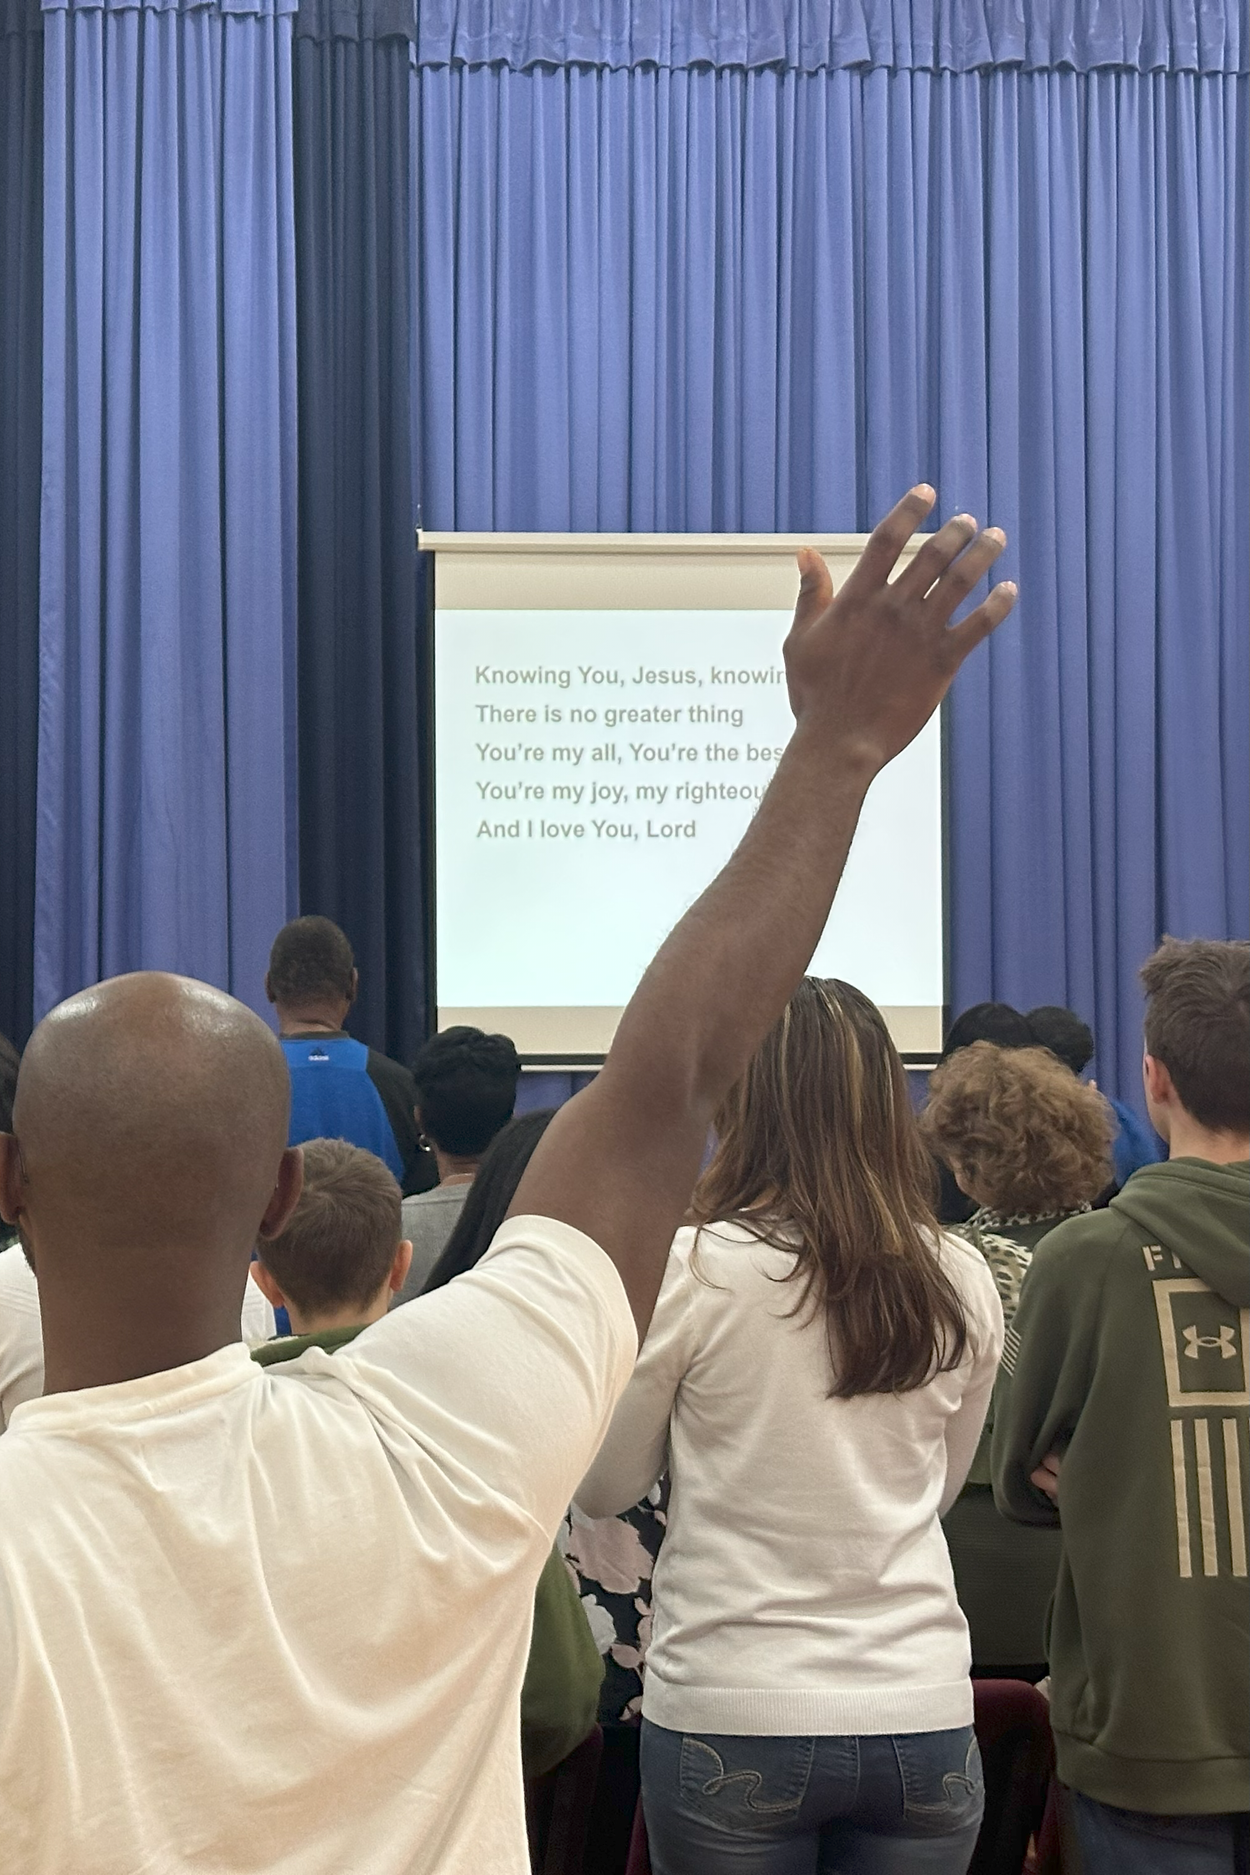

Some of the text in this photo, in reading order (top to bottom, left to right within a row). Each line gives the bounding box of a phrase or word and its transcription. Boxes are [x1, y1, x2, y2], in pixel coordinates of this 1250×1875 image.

[475, 666, 785, 689] Knowing You, Jesus, knowin
[475, 705, 744, 727] There is no greater thing
[476, 743, 783, 766] You’re my all, You’re the bes
[476, 781, 766, 805] You’re my joy, my righteou
[476, 819, 696, 841] And I love You, Lord
